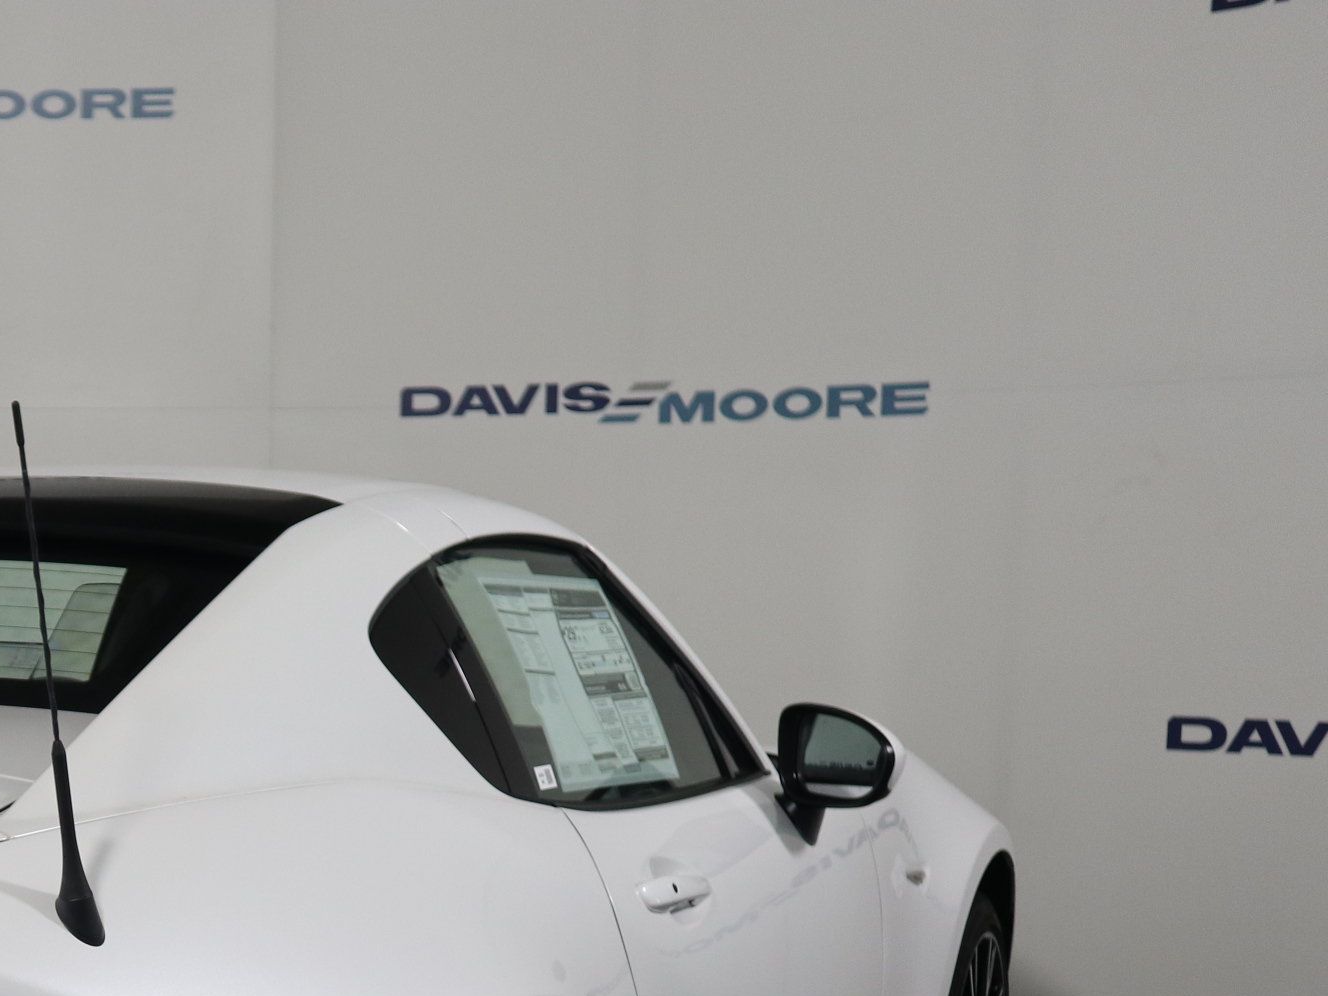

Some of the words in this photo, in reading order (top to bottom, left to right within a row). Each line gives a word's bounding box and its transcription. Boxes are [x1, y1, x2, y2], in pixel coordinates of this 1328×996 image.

[399, 381, 612, 418] DAVIS
[657, 381, 931, 424] MOORE
[1165, 715, 1328, 757] DAV
